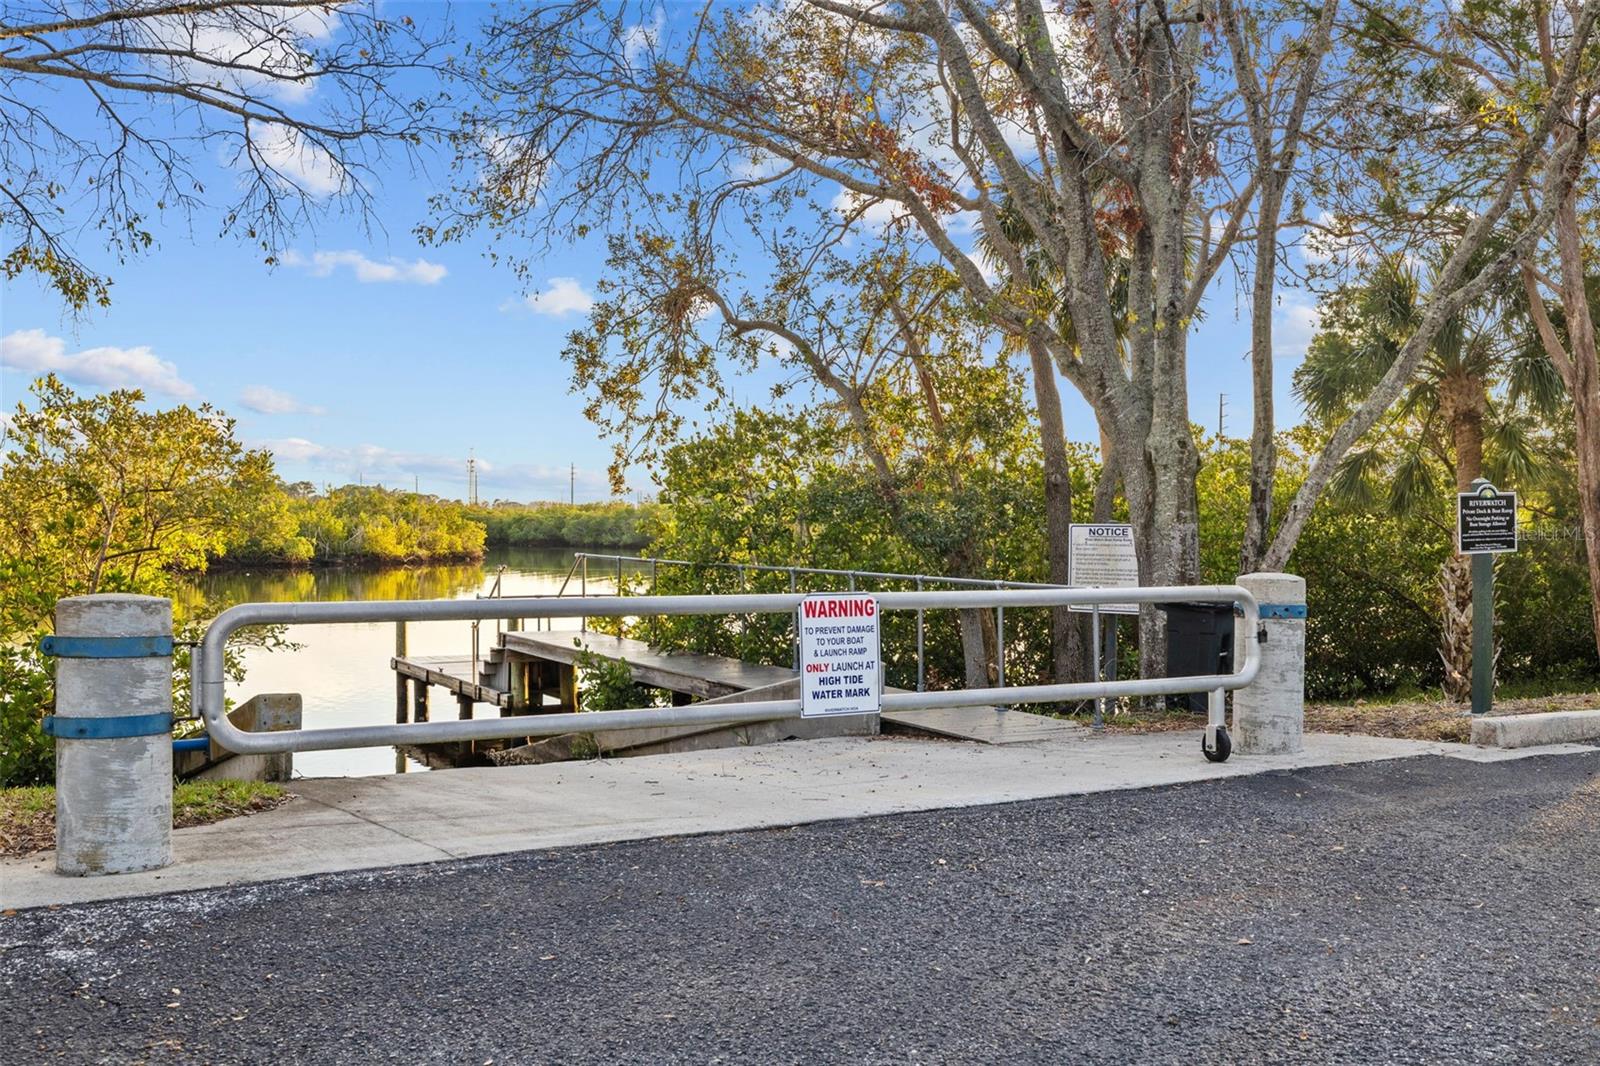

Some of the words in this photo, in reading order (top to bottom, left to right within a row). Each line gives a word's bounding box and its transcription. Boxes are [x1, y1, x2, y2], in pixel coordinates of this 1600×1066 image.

[1088, 528, 1128, 536] NOTICE
[804, 599, 874, 618] WARNING
[805, 627, 814, 635] TO
[815, 626, 845, 634] PREVENT
[847, 625, 874, 634] DAMAGE
[816, 638, 825, 646] TO
[827, 637, 846, 646] YOUR
[847, 636, 864, 644] BOAT
[820, 648, 848, 657] LAUNCH
[849, 648, 867, 656] RAMP
[806, 663, 830, 672] ONLY
[832, 662, 864, 672] LAUNCH
[865, 661, 875, 670] AT
[819, 676, 841, 686] HIGH
[844, 675, 863, 684] TIDE
[812, 690, 842, 700] WATER
[845, 688, 870, 698] MARK
